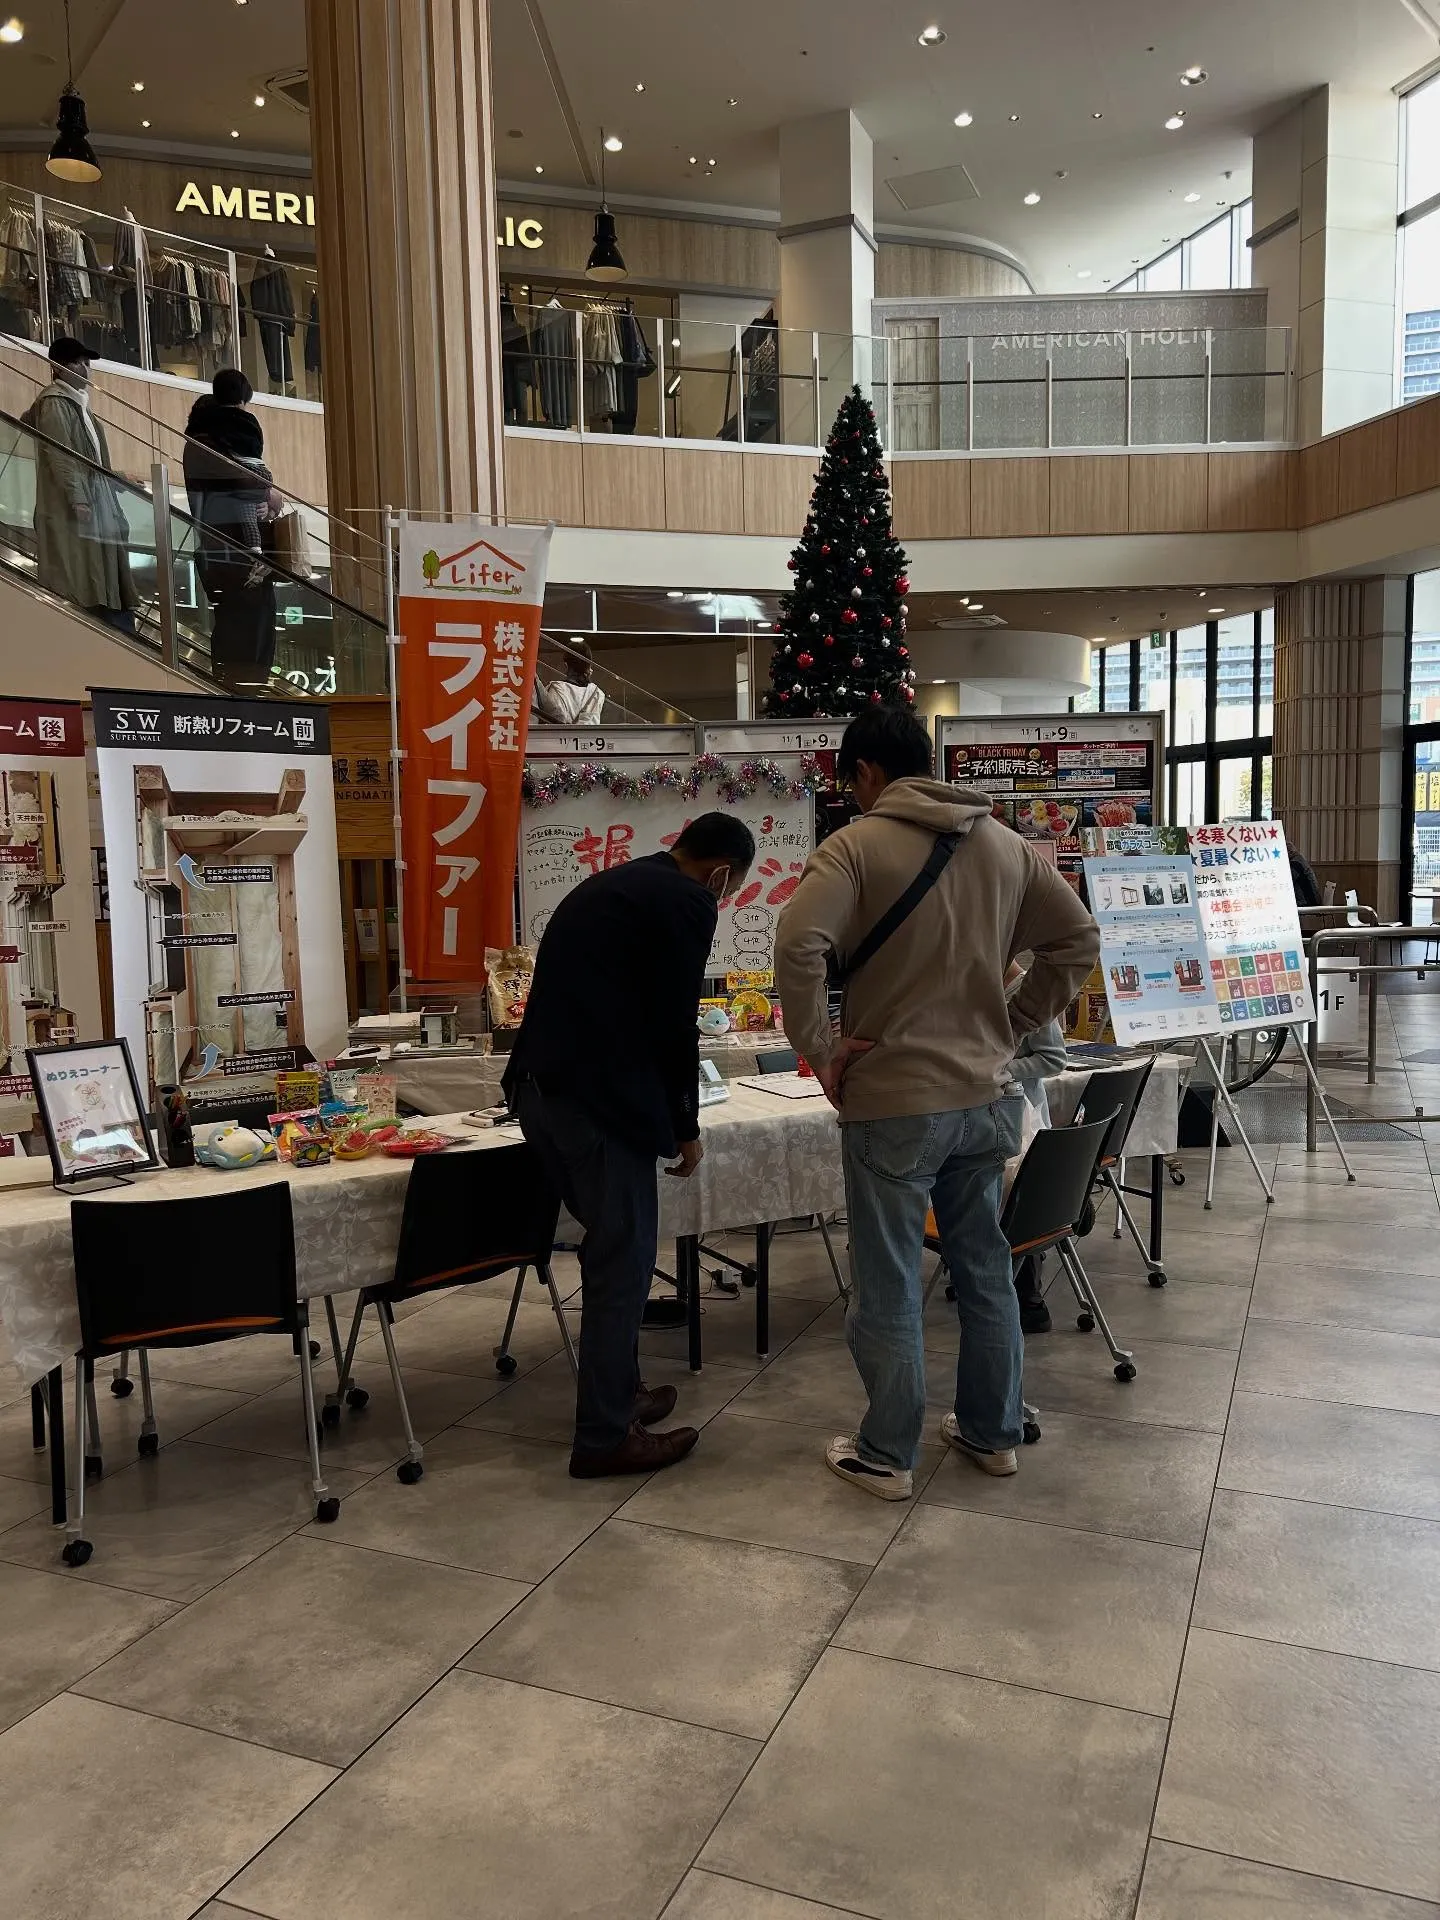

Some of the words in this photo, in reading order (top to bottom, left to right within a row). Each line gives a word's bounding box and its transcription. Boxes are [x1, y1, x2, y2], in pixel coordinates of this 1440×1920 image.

[175, 182, 316, 226] AMERI
[497, 216, 544, 249] IC
[451, 563, 515, 585] Lifer
[488, 620, 526, 752] 株式会社
[42, 720, 62, 738] 後
[173, 715, 290, 738] 断熱リフォーム
[295, 721, 312, 736] 前
[110, 733, 137, 741] SUPER
[978, 749, 1001, 758] BLACK
[1003, 747, 1027, 758] FRIDAY
[957, 759, 1040, 778] ご予約販売会
[422, 622, 488, 956] ライファー
[1105, 840, 1168, 851] 節電ガラスコート
[1196, 825, 1268, 846] 冬寒くない
[1198, 847, 1271, 867] 夏暑くない
[1250, 941, 1278, 952] GOALS
[1319, 989, 1345, 1011] 1F
[46, 1065, 121, 1082] ぬりえコーナー
